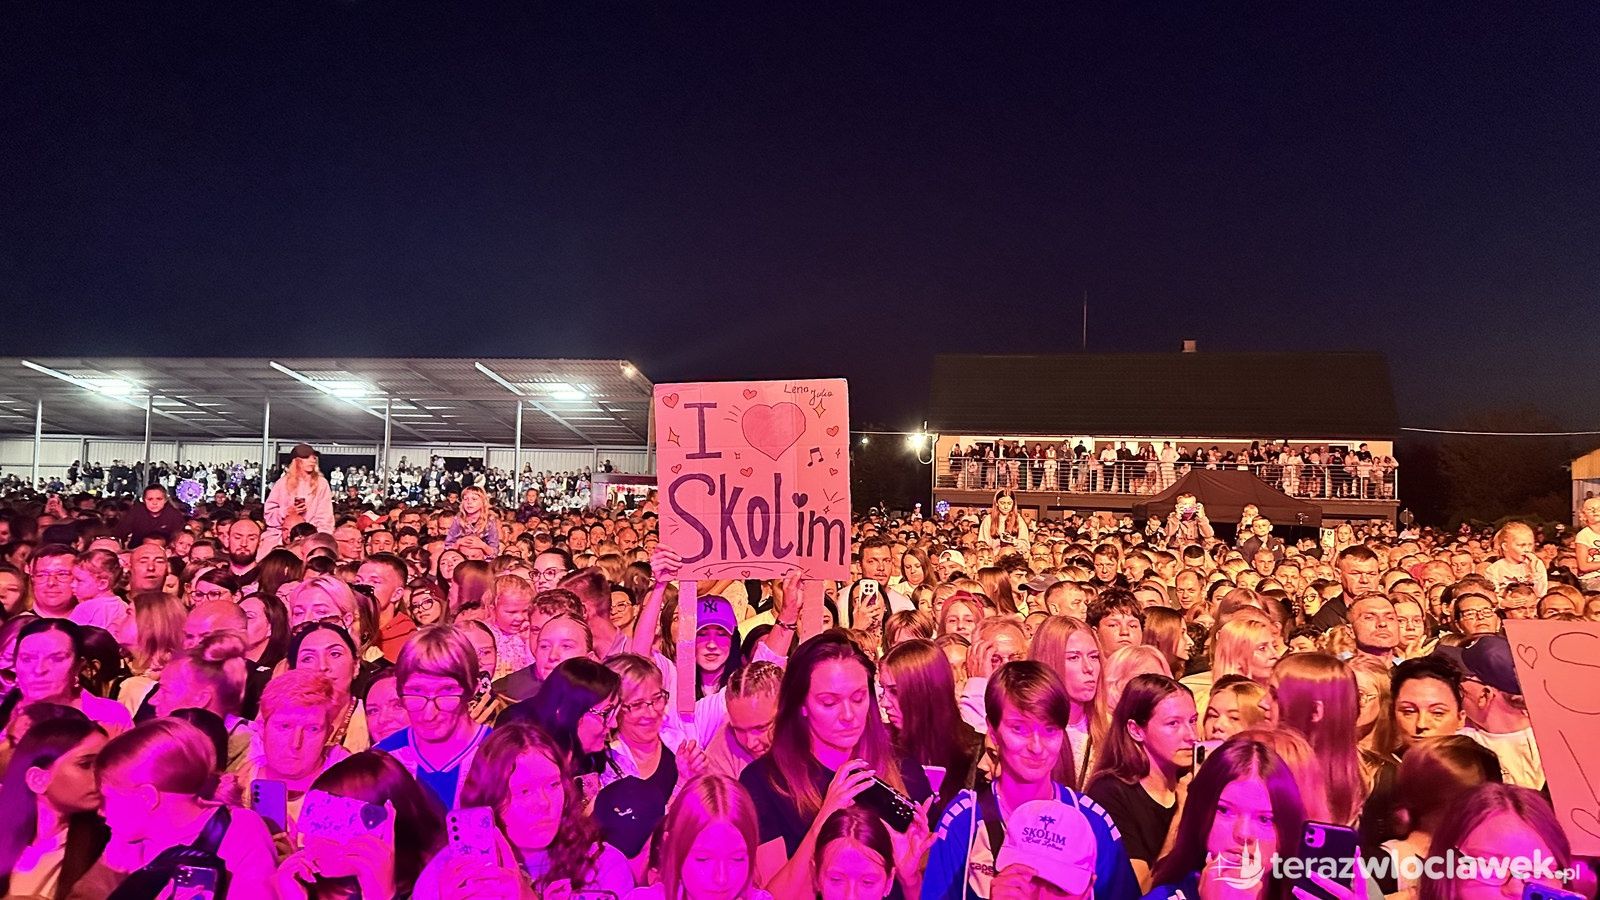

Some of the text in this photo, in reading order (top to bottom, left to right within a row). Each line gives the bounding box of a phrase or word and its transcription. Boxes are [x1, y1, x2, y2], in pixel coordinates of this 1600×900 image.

[683, 402, 723, 460] I
[668, 472, 846, 566] Skolim
[1021, 826, 1067, 846] SKOLIM
